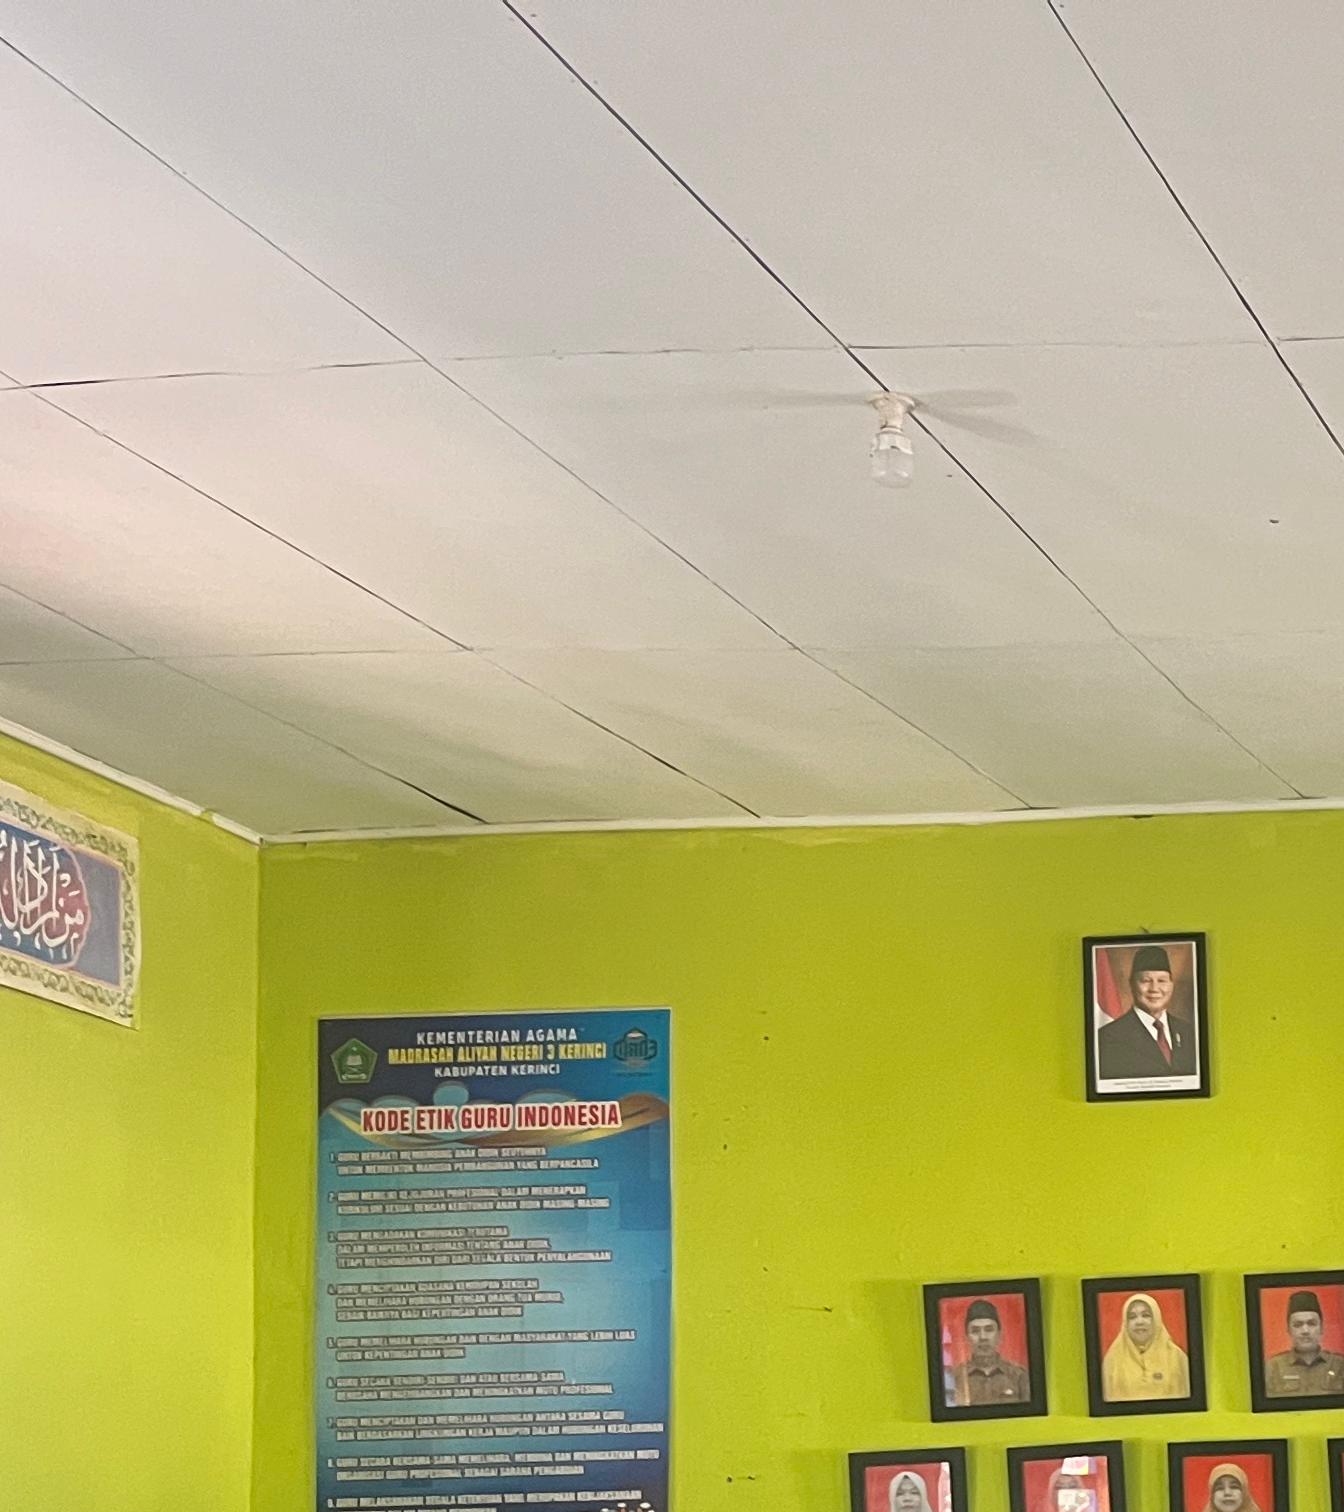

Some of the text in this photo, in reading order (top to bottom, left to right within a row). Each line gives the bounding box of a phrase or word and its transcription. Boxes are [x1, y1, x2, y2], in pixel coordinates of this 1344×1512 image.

[417, 1028, 577, 1044] KEMENTERIAN AGAMA
[502, 1044, 543, 1061] NEGERI
[548, 1044, 555, 1059] 3
[559, 1042, 606, 1059] KERINCI
[435, 1063, 560, 1078] KABUPATEN KERINCI
[362, 1103, 619, 1132] KODE ETIK GURU INDONESIA
